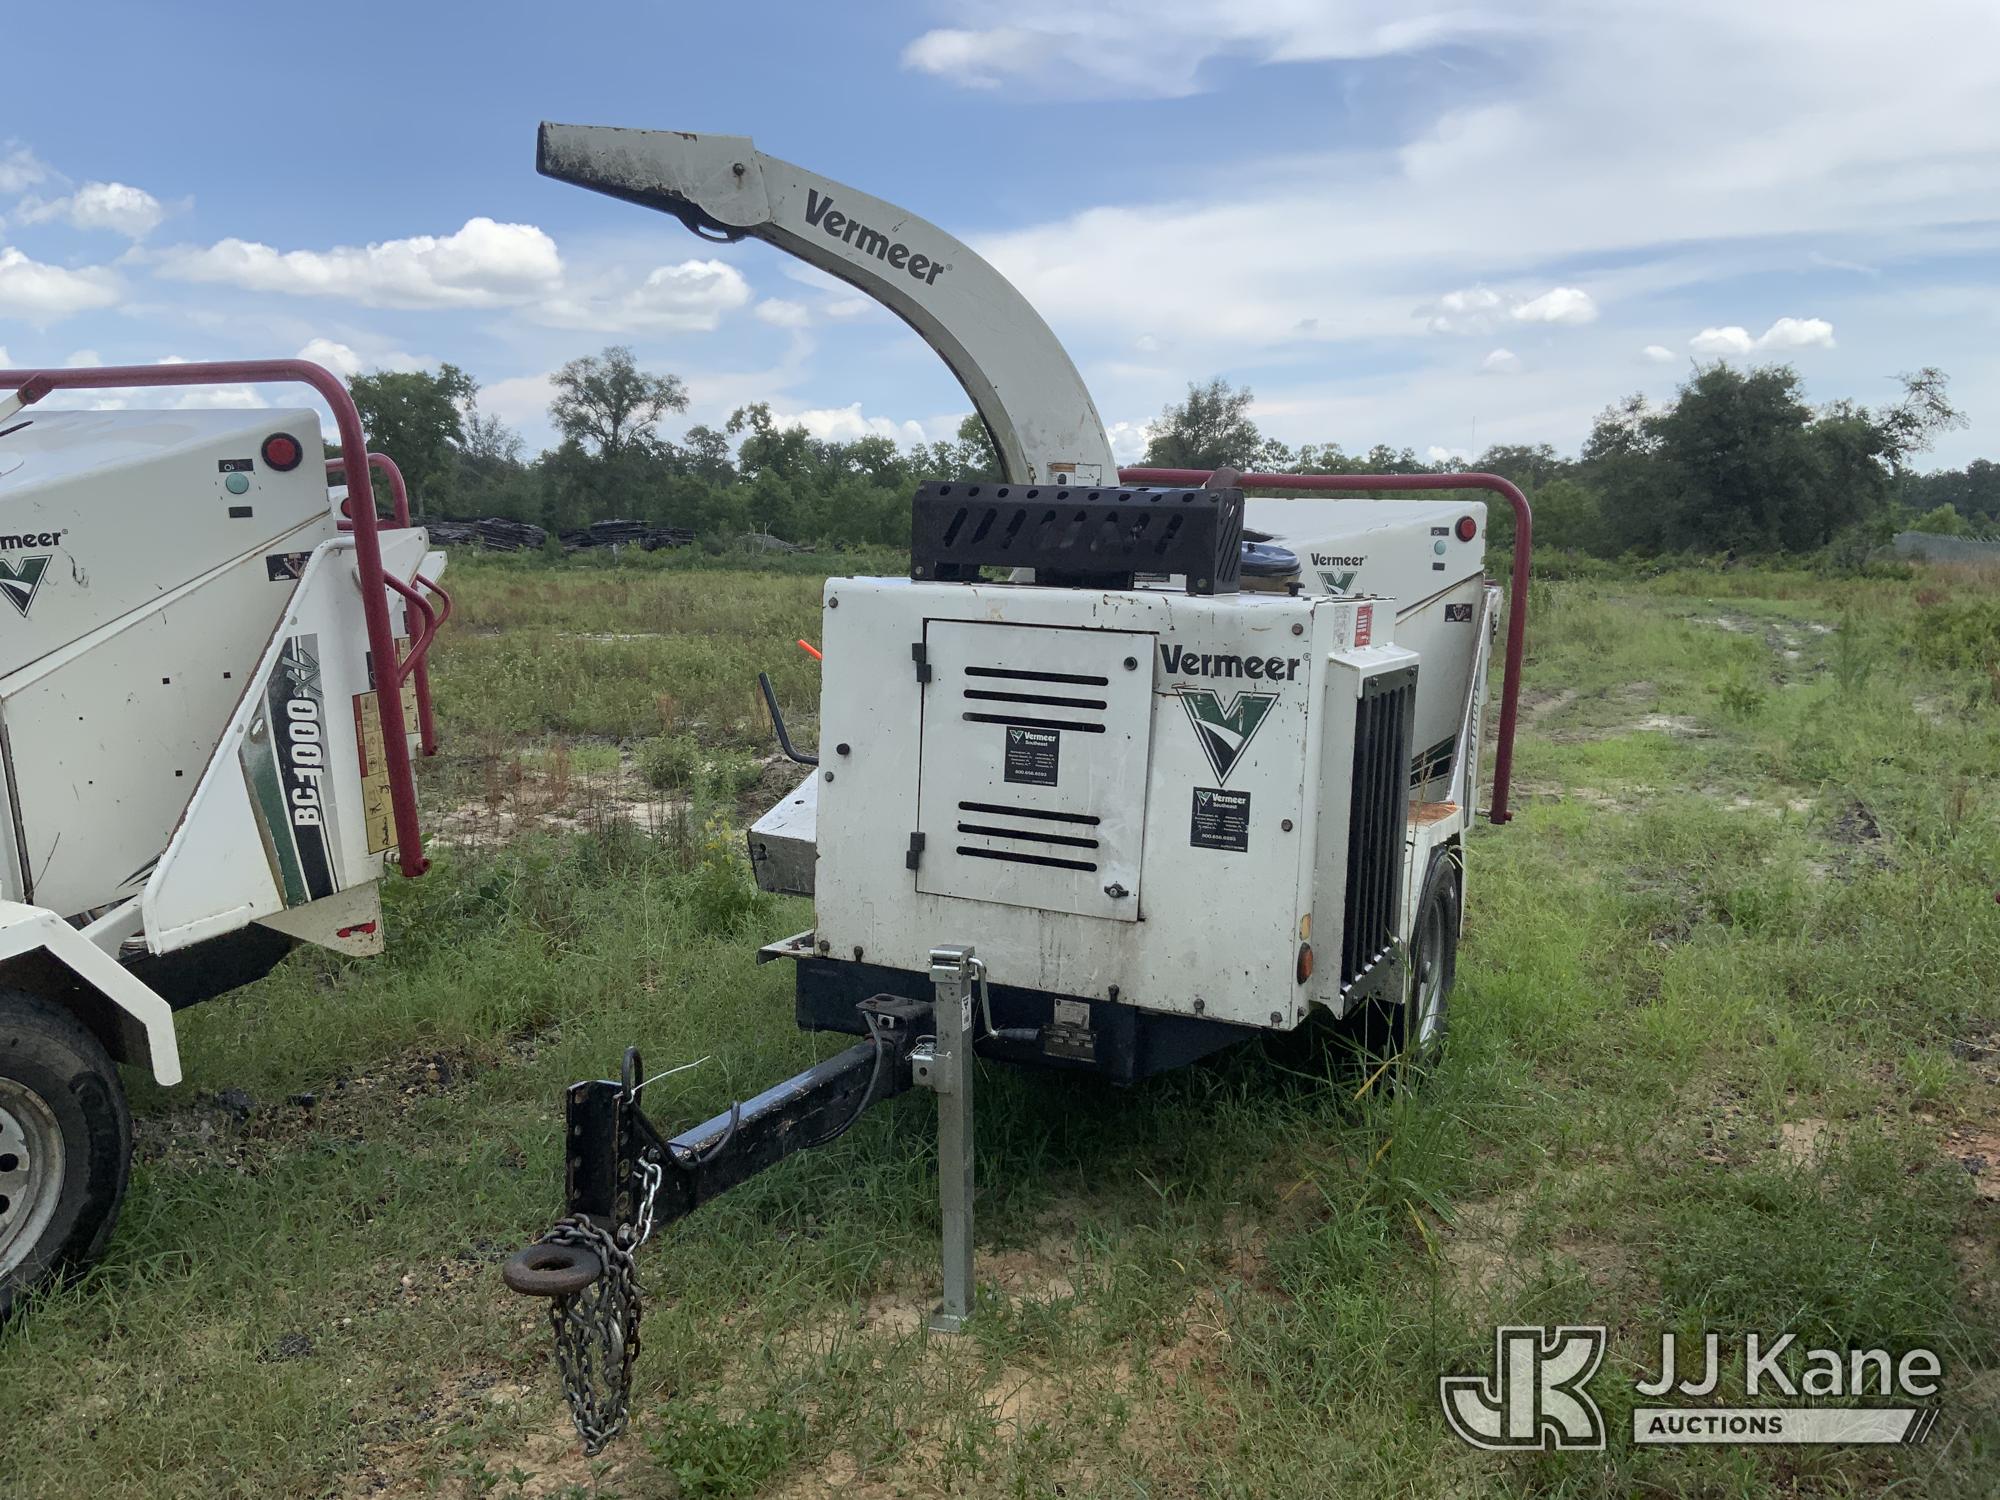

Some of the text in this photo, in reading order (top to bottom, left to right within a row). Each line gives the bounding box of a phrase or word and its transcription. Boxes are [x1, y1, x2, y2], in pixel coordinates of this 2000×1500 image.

[805, 188, 945, 286] Vermeer
[1310, 552, 1364, 567] Vermeer
[1160, 643, 1301, 681] Vermeer
[1024, 731, 1056, 742] Vermeer
[1212, 792, 1247, 804] Vermeer
